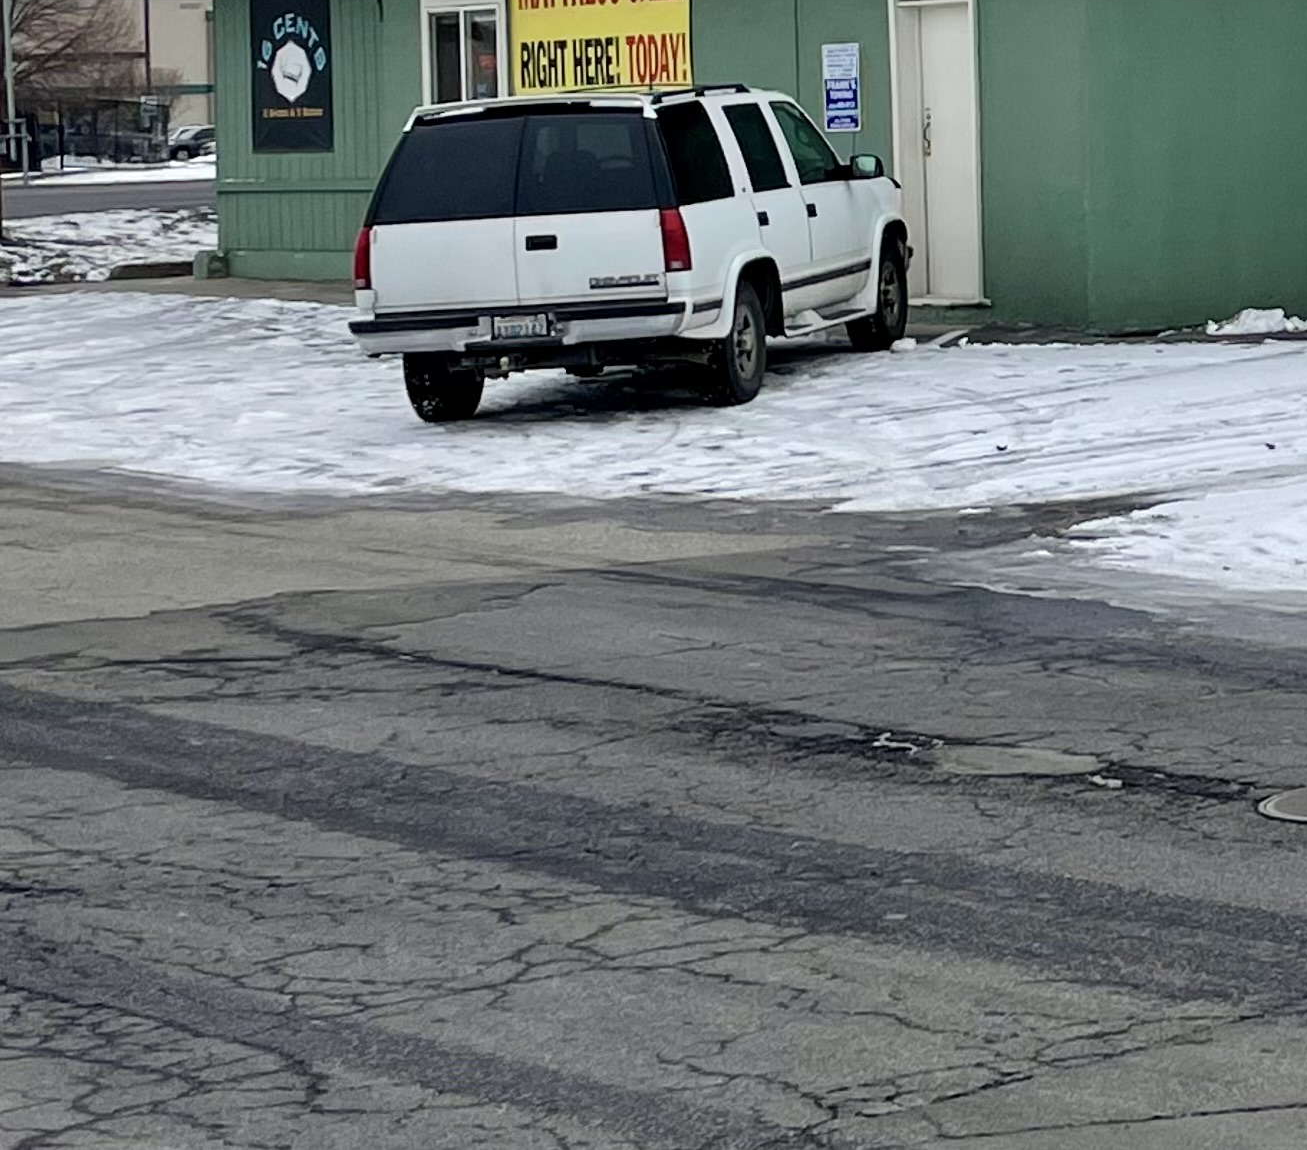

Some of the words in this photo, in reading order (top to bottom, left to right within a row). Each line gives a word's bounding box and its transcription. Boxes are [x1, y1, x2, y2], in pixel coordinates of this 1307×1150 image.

[520, 40, 568, 88] RIGHT
[572, 36, 621, 86] HERE!
[626, 33, 688, 83] TODAY!
